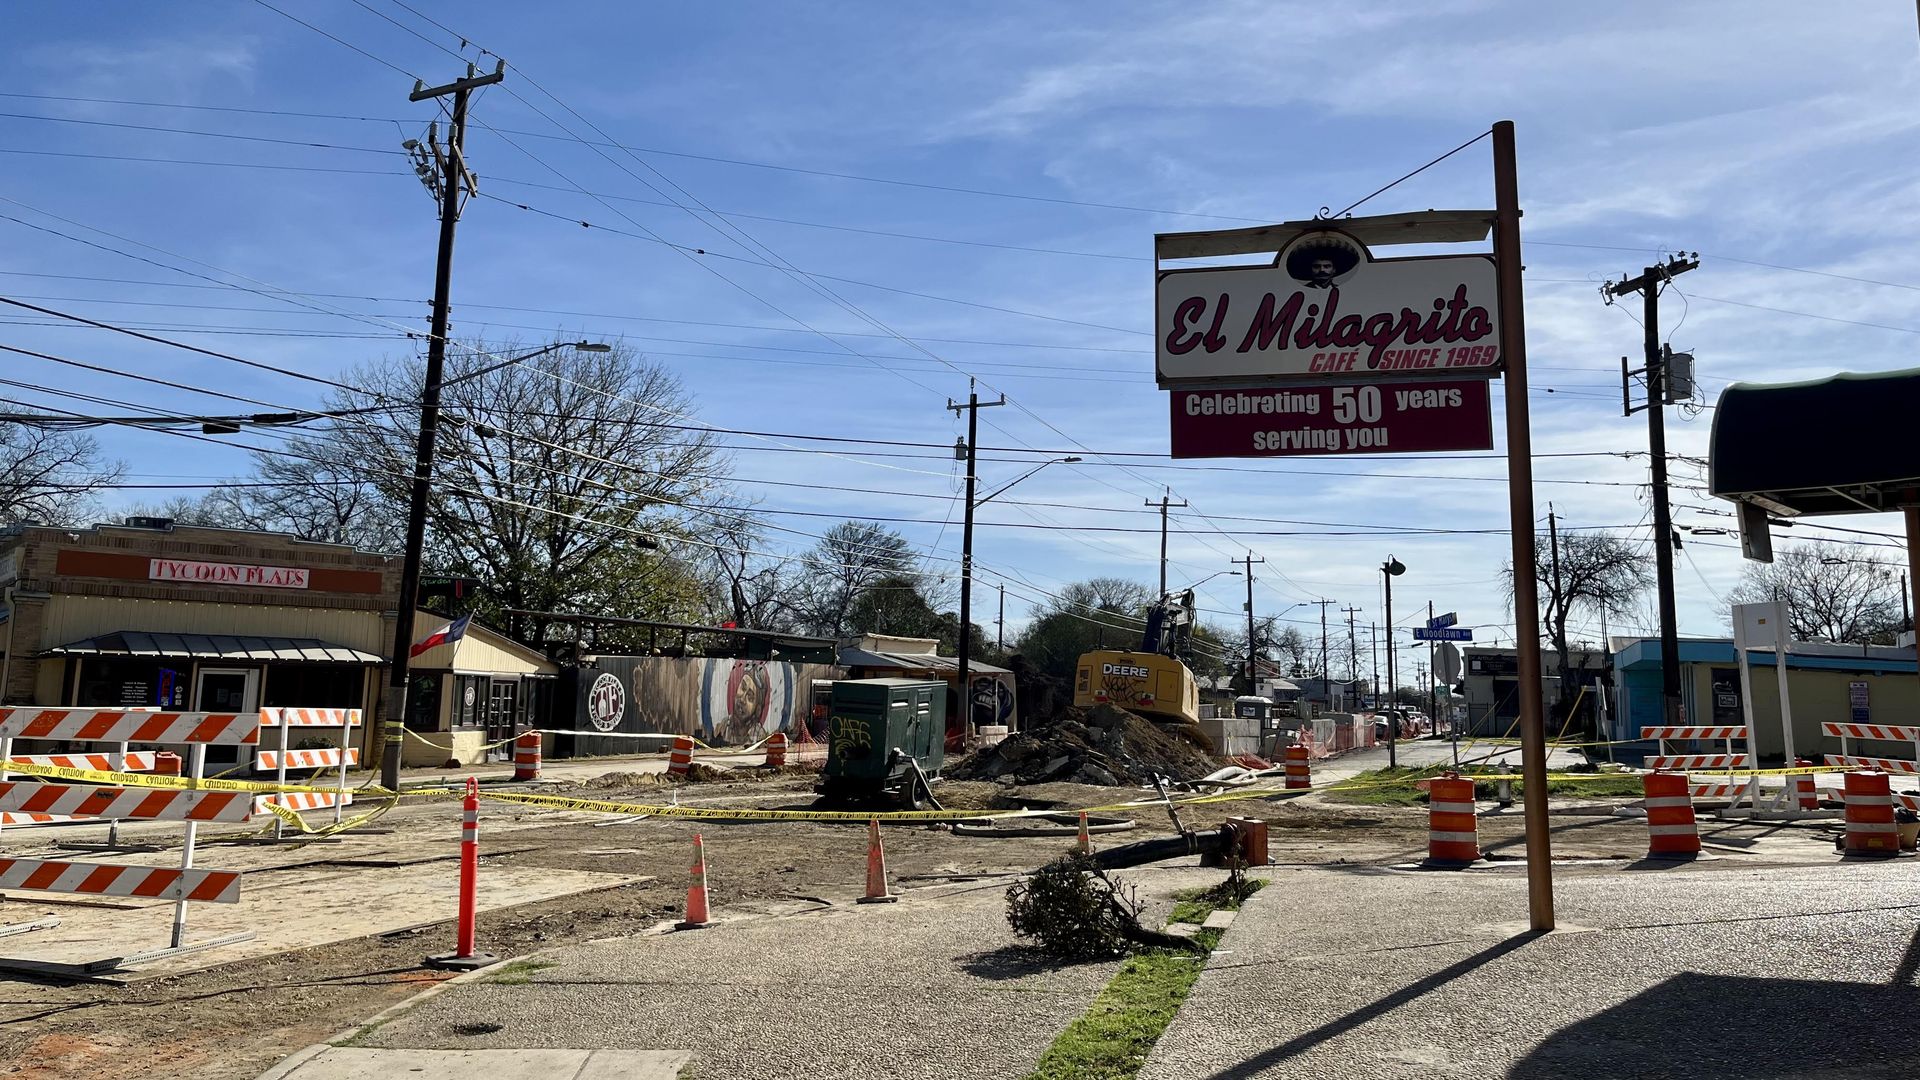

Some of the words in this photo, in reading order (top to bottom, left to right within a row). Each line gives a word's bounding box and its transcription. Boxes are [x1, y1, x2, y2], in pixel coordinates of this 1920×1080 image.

[1166, 293, 1230, 355] El
[1236, 284, 1492, 369] Milagrito
[1308, 347, 1360, 372] CAFÉ
[1379, 349, 1441, 370] SINCE
[1446, 345, 1498, 367] 1969
[1185, 391, 1320, 416] Celebrating
[1333, 386, 1382, 424] 50
[1395, 388, 1462, 411] years
[1253, 427, 1341, 450] serving
[1346, 427, 1389, 450] you
[154, 559, 239, 582] TYCOON
[245, 566, 305, 586] FLATS
[1416, 628, 1421, 638] E
[1422, 628, 1461, 639] Woodlawn
[1103, 663, 1149, 678] DEERE
[538, 798, 569, 808] CUIDADO
[584, 801, 615, 812] CAUTION
[627, 805, 658, 815] CUIDADO
